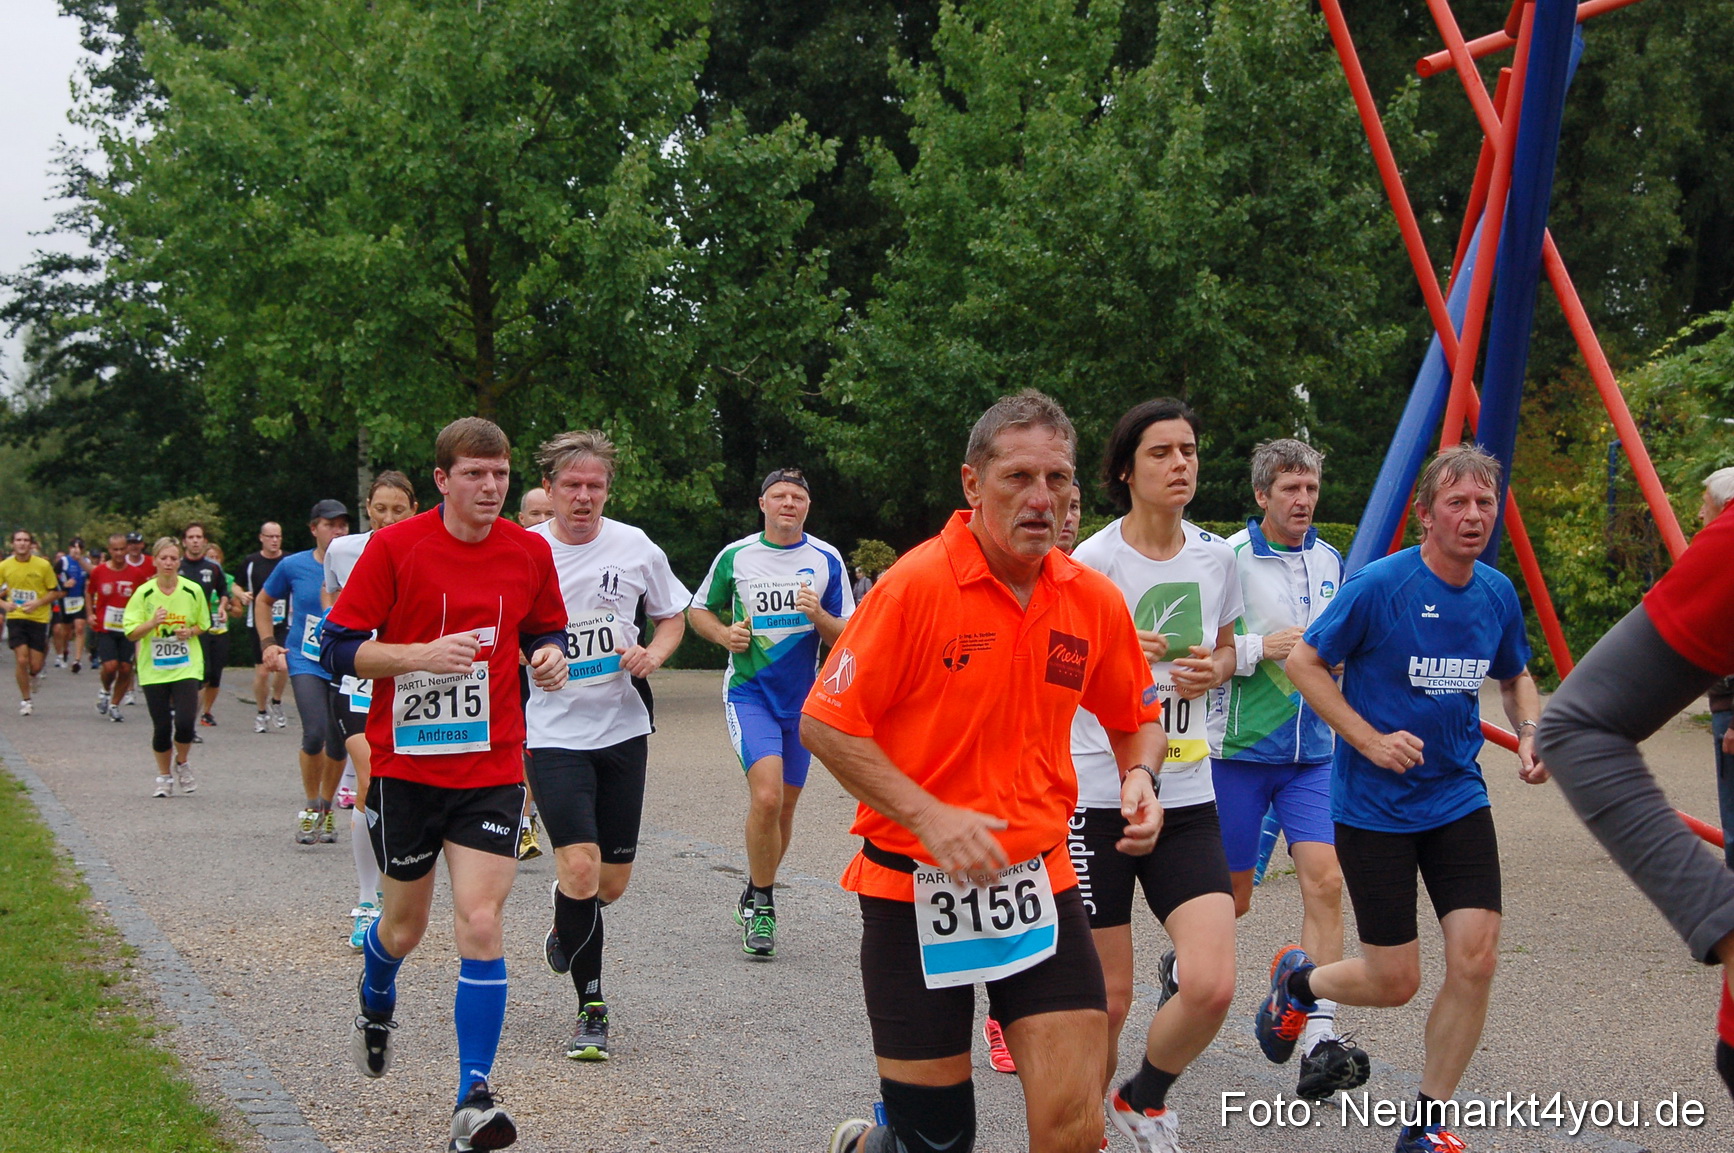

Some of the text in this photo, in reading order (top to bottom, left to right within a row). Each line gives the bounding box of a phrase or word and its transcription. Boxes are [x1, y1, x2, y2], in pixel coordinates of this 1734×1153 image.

[756, 590, 796, 612] 304
[566, 617, 603, 629] Neumarkt
[767, 616, 800, 626] Gerhard
[155, 643, 188, 656] 2026
[1408, 656, 1490, 678] HUBER
[397, 673, 473, 692] PARTL Neumarkt
[403, 685, 482, 721] 2315
[418, 729, 468, 742] Andreas
[482, 821, 510, 836] JAKO
[917, 873, 952, 884] PART
[931, 879, 1042, 936] 3156
